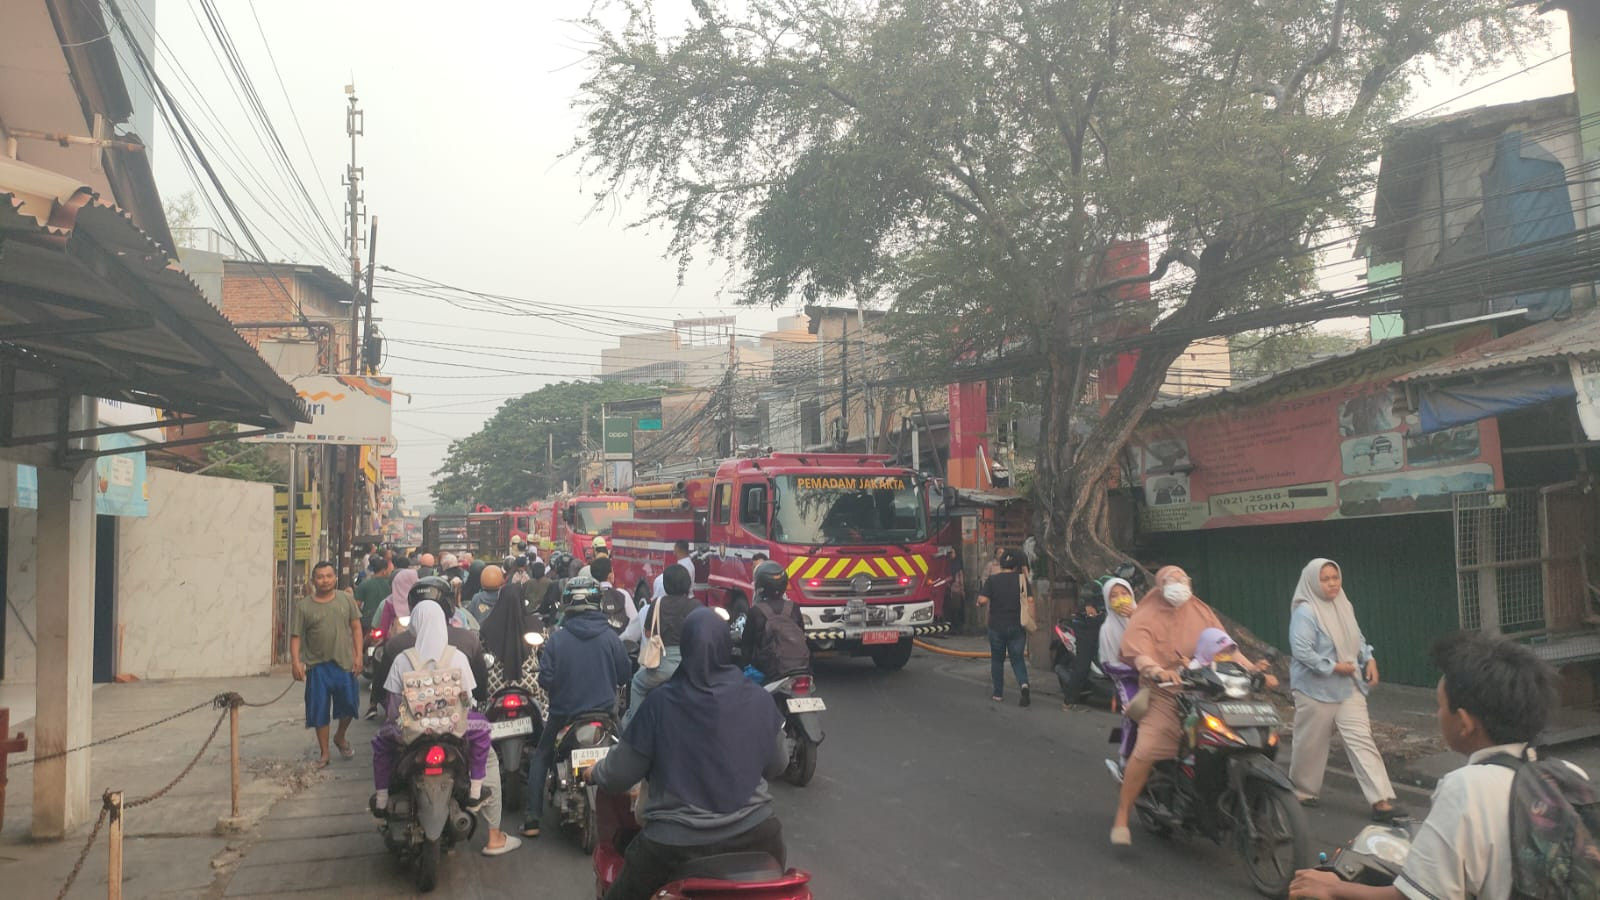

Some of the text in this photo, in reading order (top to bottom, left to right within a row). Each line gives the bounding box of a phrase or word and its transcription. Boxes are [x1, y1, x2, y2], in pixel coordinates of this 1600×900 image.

[797, 478, 905, 490] PEMADAM JAKARTA
[1215, 492, 1288, 506] 0821-2588-
[1246, 500, 1296, 514] (TOHA)
